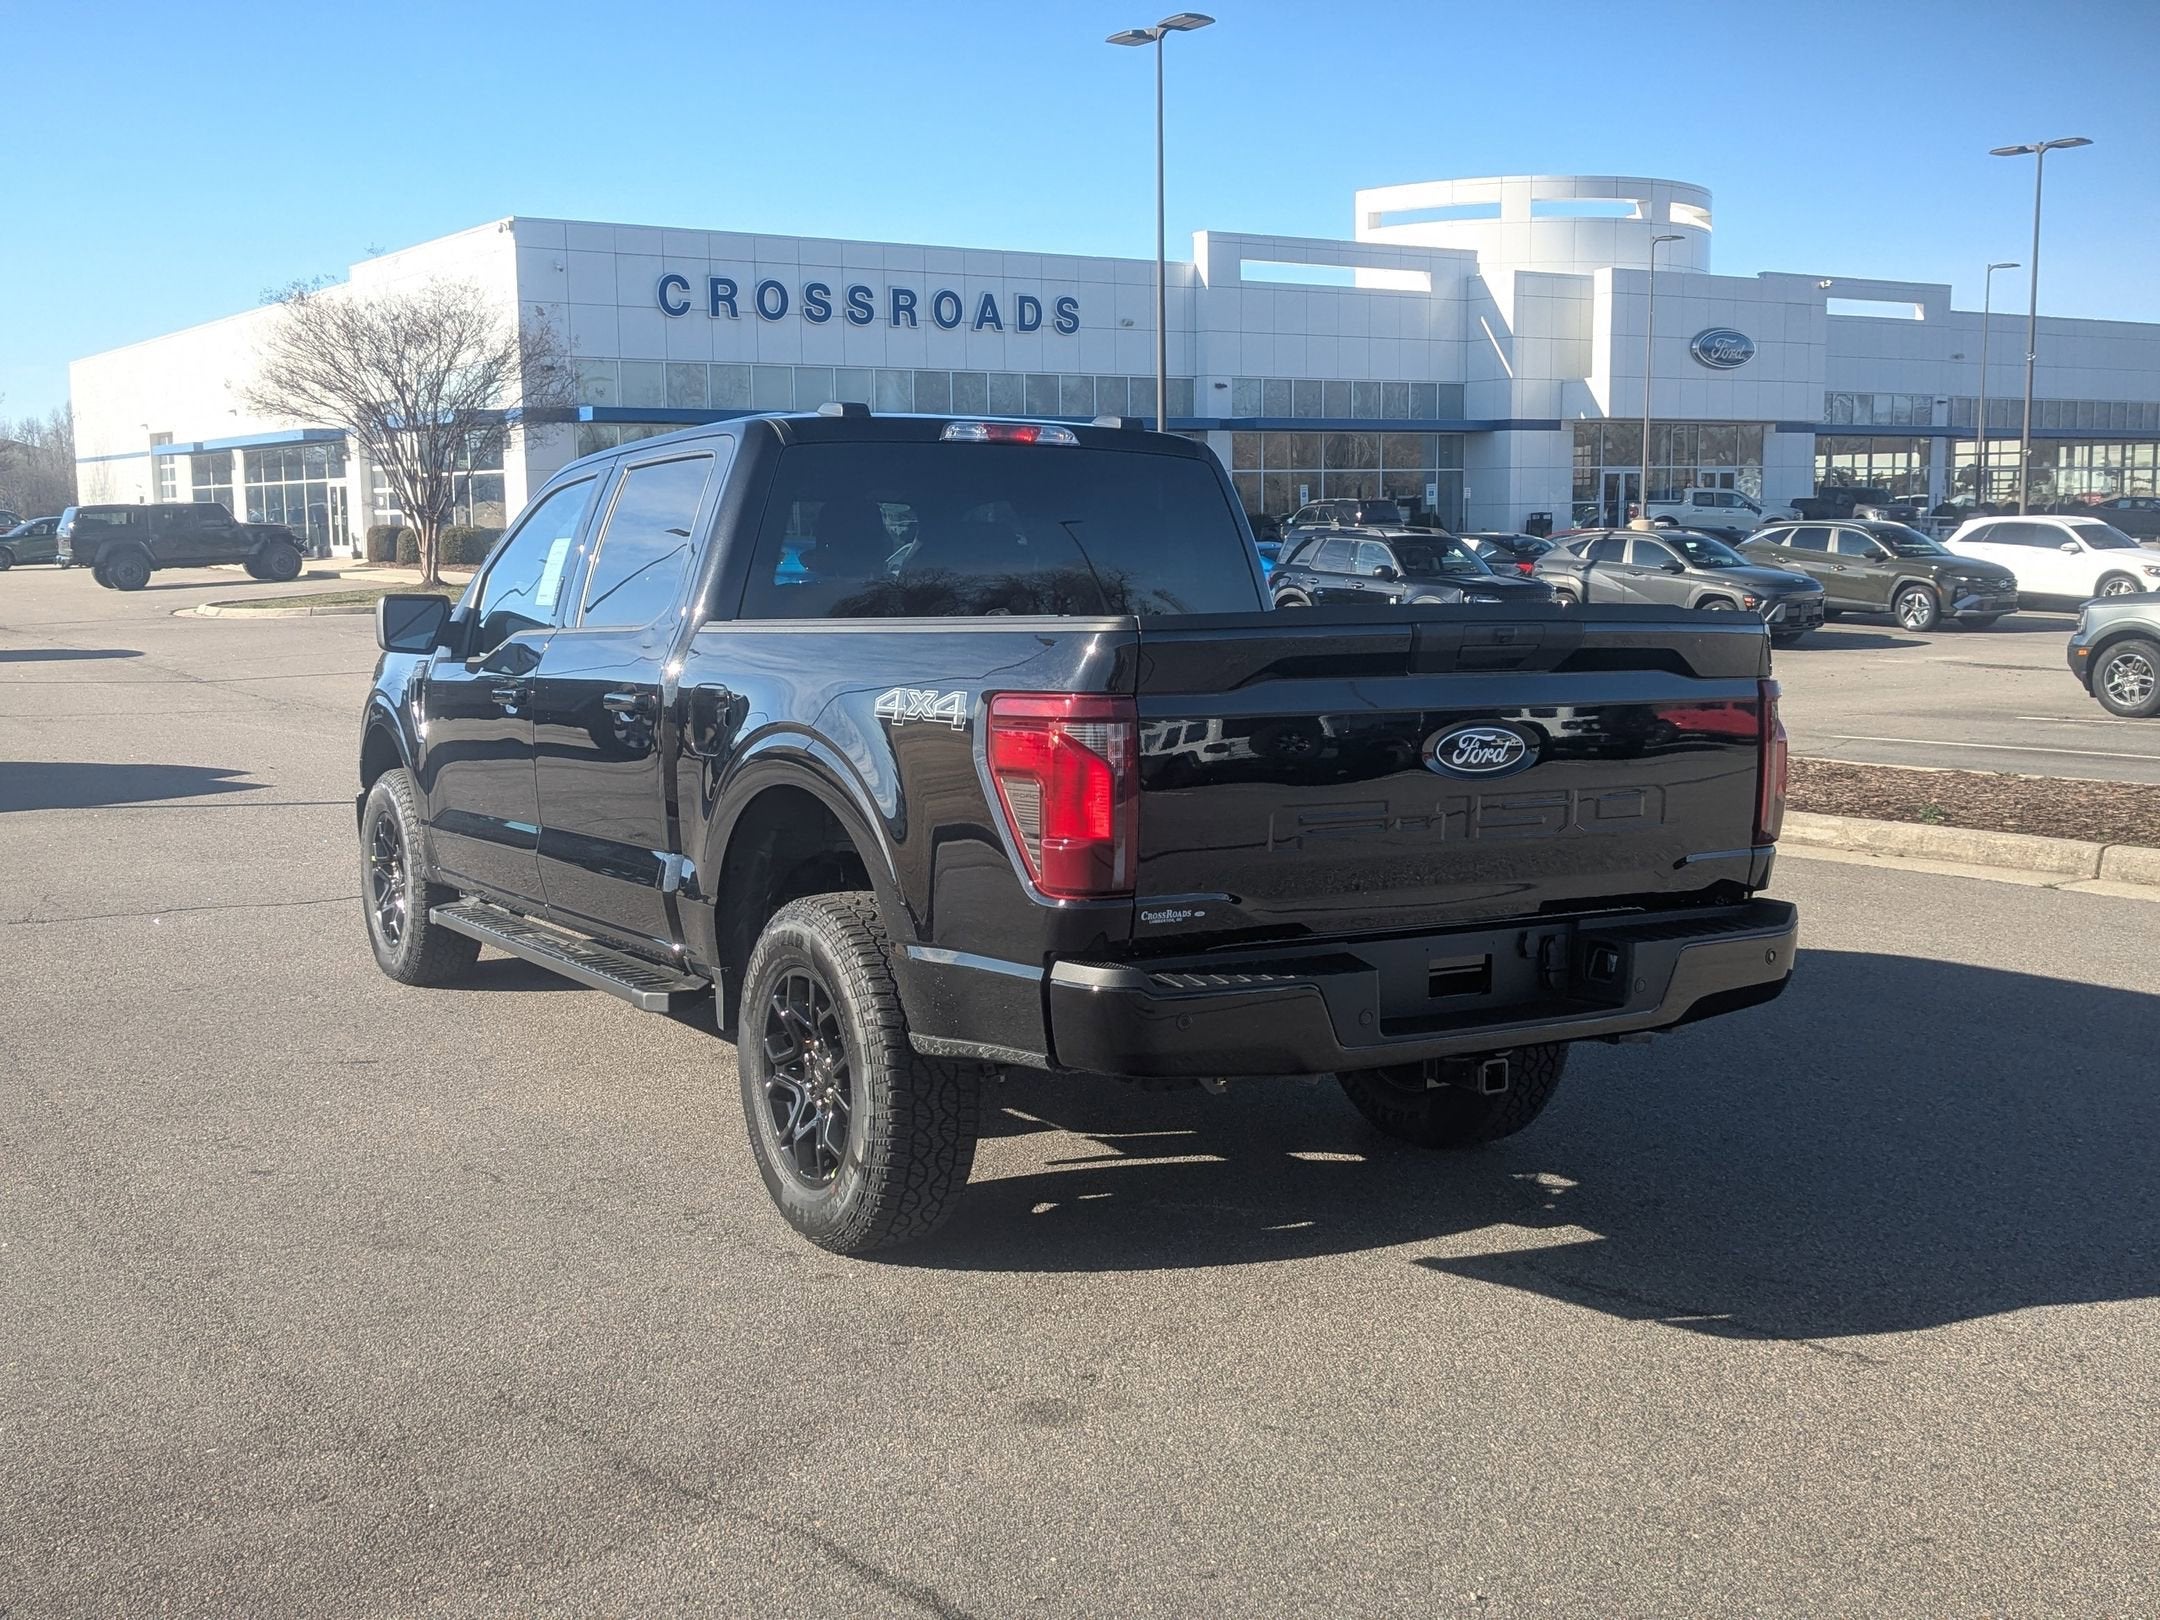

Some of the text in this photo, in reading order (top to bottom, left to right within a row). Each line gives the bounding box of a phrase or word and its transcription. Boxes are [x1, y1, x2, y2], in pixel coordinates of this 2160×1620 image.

[657, 272, 1081, 335] CROSSROADS
[1711, 338, 1746, 359] Ford
[1452, 734, 1510, 764] Ford
